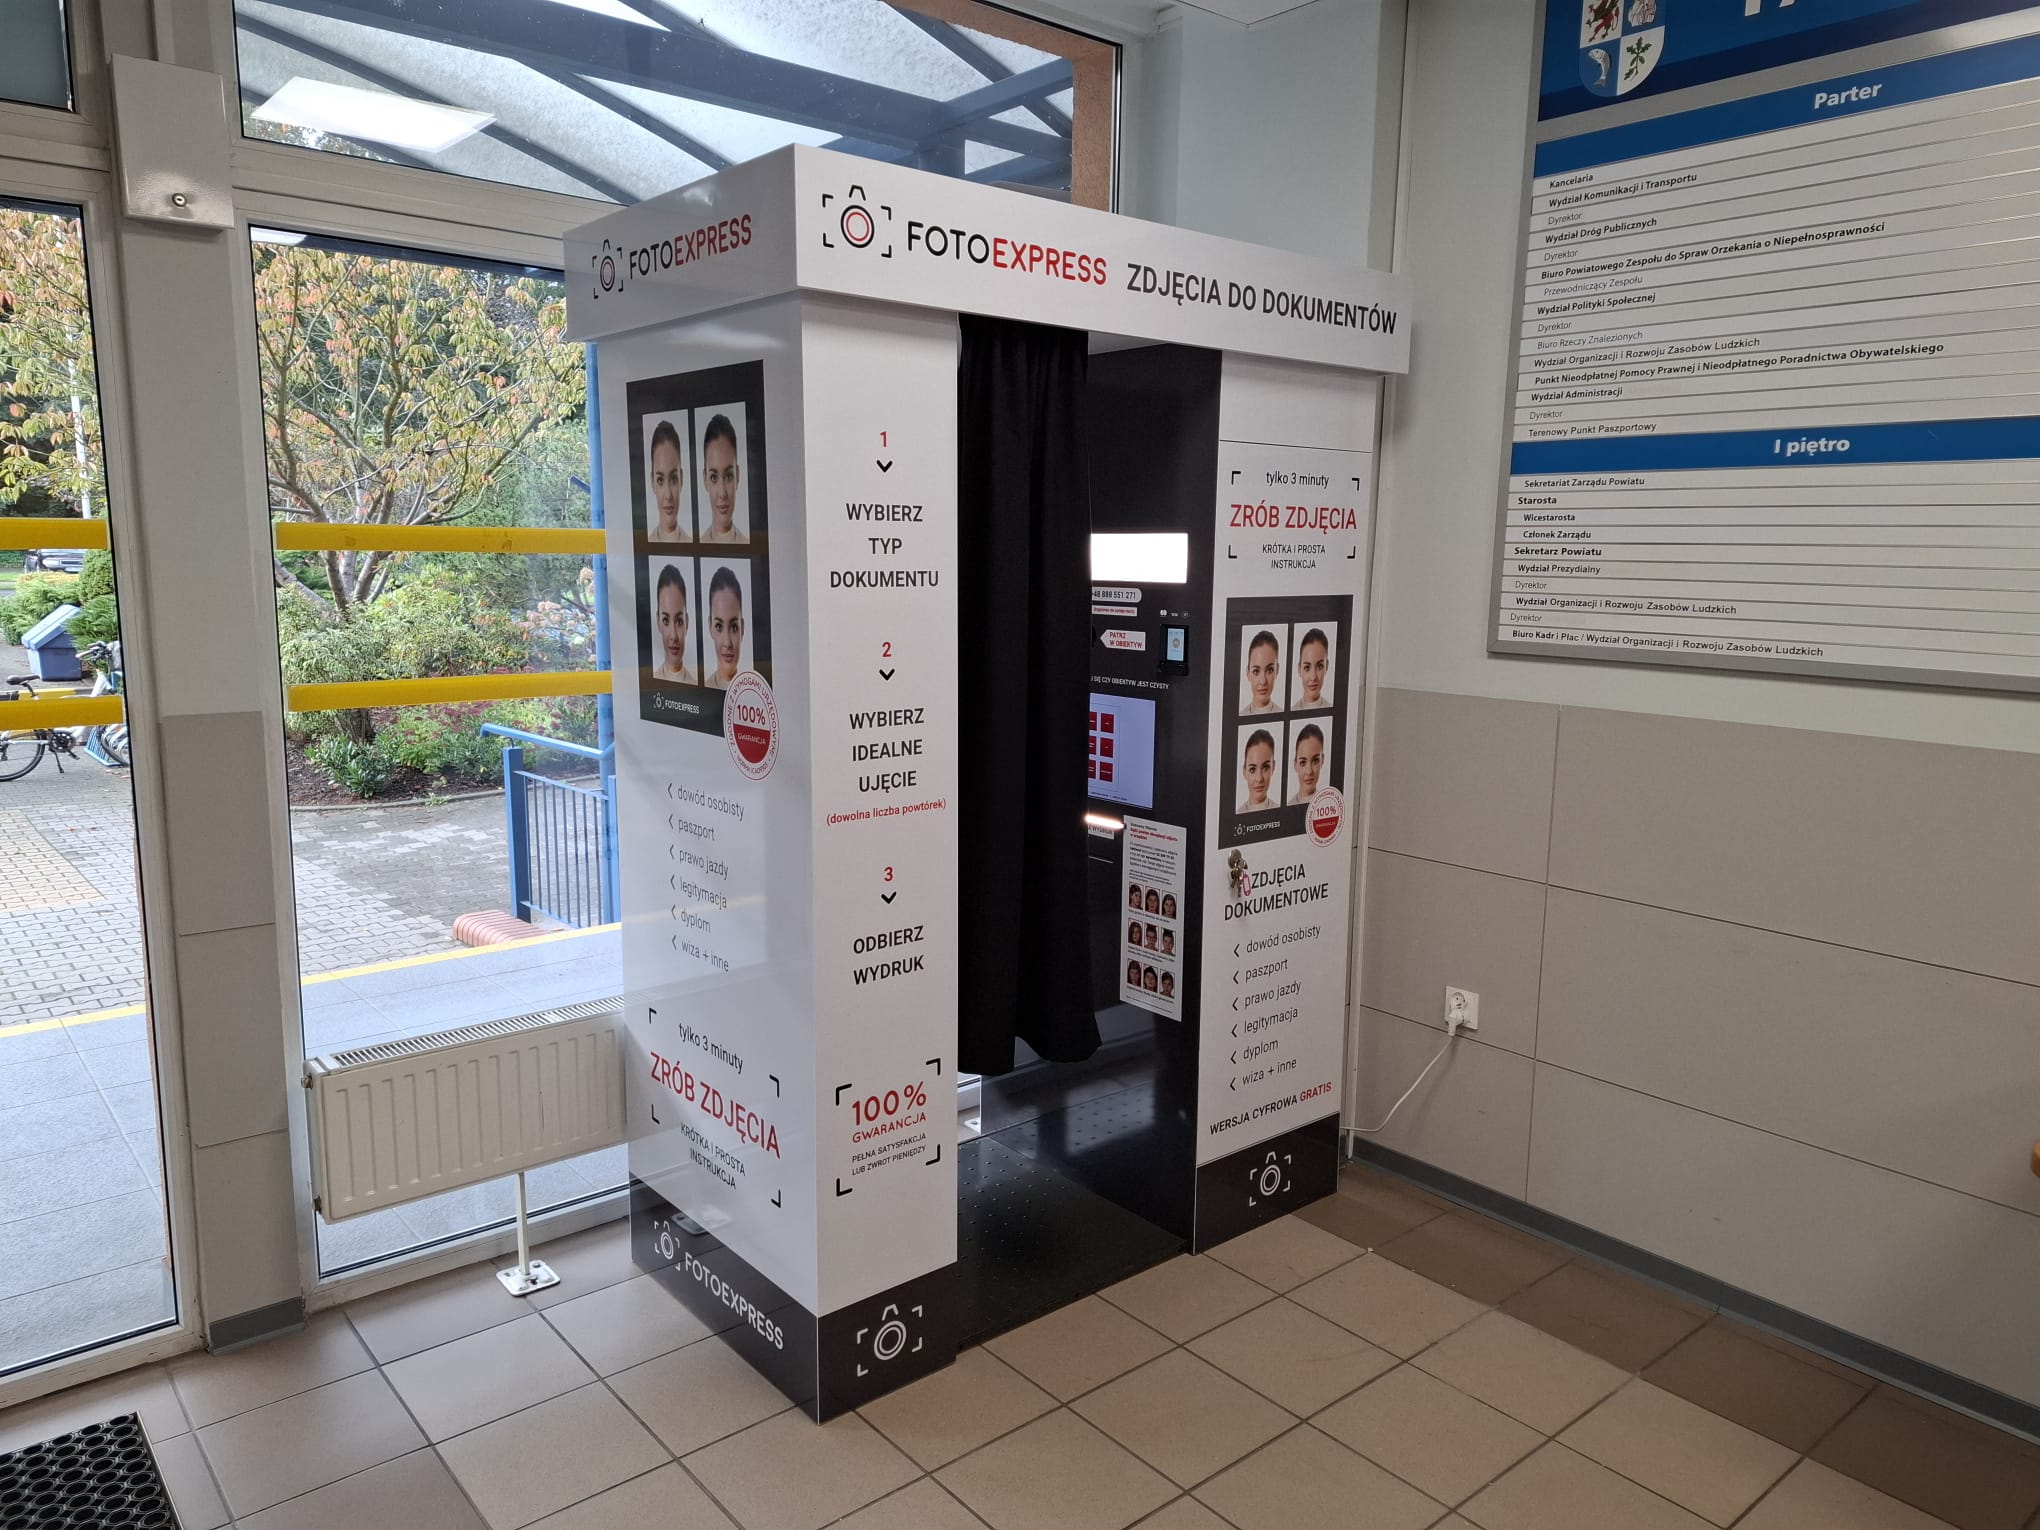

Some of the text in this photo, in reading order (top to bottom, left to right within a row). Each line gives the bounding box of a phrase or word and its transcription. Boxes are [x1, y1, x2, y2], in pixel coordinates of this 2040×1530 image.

[1815, 81, 1883, 110] Parter
[1550, 174, 1593, 189] Kancelaria
[1550, 174, 1697, 209] Wydział Komunikacji Transportu
[1549, 212, 1582, 225] Dyrektor
[1546, 218, 1657, 245] Wydział Dróg Publicznych
[630, 214, 752, 280] FOTOEXPRESS
[1542, 222, 1885, 279] Biuro Powiatowego Zespołu do Spraw Orzekania Niepełnosprawności
[1544, 250, 1578, 262] Dyrektor
[908, 220, 1396, 335] FOTOEXPRESS ZDJĘCIA DO DOKUMENTÓW
[1544, 276, 1643, 296] Przewodniczący Zespołu
[1538, 292, 1656, 317] Wydział Polityki Społecznej
[1538, 321, 1572, 334] Dyrektor
[1538, 331, 1643, 350] Biuro Rzeczy Znalezionych
[1534, 338, 1760, 369] Wydział Organizacji Rozwoju Zasobów Ludzkich
[1536, 342, 1944, 385] Punkt Nieodpłatnej Pomocy Prawnej Nieodpłatnego Poradnictwa Obywatelskiego
[1531, 386, 1623, 404] Wydział Administracji
[1530, 410, 1563, 421] Dyrektor
[880, 431, 887, 447] 1
[1529, 422, 1657, 439] Terenowy Punkt Paszportowy
[1774, 436, 1851, 456] I piętro
[1266, 472, 1329, 489] tylko 3 minuty
[1524, 476, 1645, 488] Sekretariat Zarządu Powiatu
[1518, 496, 1557, 505] Starosta
[846, 503, 923, 522] WYBIERZ
[1230, 500, 1357, 535] ZRÓB ZDJĘCIA
[1524, 513, 1576, 522] Wicestarosta
[868, 538, 903, 554] TYP
[1523, 530, 1592, 541] Członek Zarządu
[1262, 542, 1326, 554] KRÓTKA PROSTA
[1514, 547, 1602, 557] Sekretarz Powiatu
[1271, 560, 1316, 569] INSTRUKCJA
[1518, 564, 1601, 576] Wydział Prezydialny
[830, 570, 939, 588] DOKUMENTU
[1515, 581, 1547, 590] Dyrektor
[1114, 591, 1136, 600] 551 271
[1516, 597, 1737, 614] Wydział Organizacji Rozwoju Zasobów Ludzkich
[1510, 613, 1542, 623] Dyrektor
[1110, 632, 1126, 640] PATRZ
[1116, 640, 1143, 649] OBIEKTYW
[1512, 630, 1824, 657] Biuro Kadr Płac Wydział Organizacji Rozwoju Zasobów Ludzkich
[882, 642, 892, 657] 2
[1150, 682, 1169, 690] CZYSTY
[665, 700, 699, 714] FOTOEXPRESS
[737, 704, 766, 725] 100%
[850, 708, 924, 730] WYBIERZ
[738, 733, 766, 744] GWARANCJA
[852, 739, 923, 761] IDEALNE
[859, 771, 917, 793] UJĘCIE
[677, 784, 745, 821] dowód osobisty
[826, 798, 946, 826] (dowolna liczba powtórek)
[1317, 806, 1336, 816] 100%
[678, 818, 715, 842] paszport
[1246, 821, 1280, 833] FOTOEXPRESS
[679, 848, 729, 880] prawo jazdy
[884, 867, 893, 881] 3
[1251, 864, 1306, 889] ZDJĘCIA
[680, 878, 727, 908] legitymacja
[1224, 883, 1329, 921] DOKUMENTOWE
[680, 907, 711, 933] dyplom
[853, 926, 924, 954] ODBIERZ
[1246, 925, 1321, 954] dowód osobisty
[682, 942, 729, 972] wiza + inne
[854, 956, 924, 985] WYDRUK
[1245, 958, 1288, 983] paszport
[1244, 981, 1302, 1010] prawo jazdy
[1244, 1008, 1298, 1035] legitymacja
[679, 1023, 743, 1074] tylko 3 minuty
[1243, 1038, 1279, 1061] dyplom
[1242, 1058, 1297, 1086] wiza + inne
[651, 1052, 781, 1159] ZRÓB ZDJĘCIA
[852, 1081, 927, 1126] 100%
[1210, 1081, 1332, 1135] WERSJA CYFROWA GRATIS
[852, 1112, 927, 1143] GWARANCJA
[681, 1122, 745, 1177] KRÓTKA PROSTA
[852, 1133, 926, 1163] PEŁNA SATYSFAKCJA
[690, 1148, 736, 1190] INSTRUKCJA
[852, 1145, 926, 1176] LUB ZWROT PIENIĘDZY
[684, 1253, 784, 1351] FOTOEXPRESS
